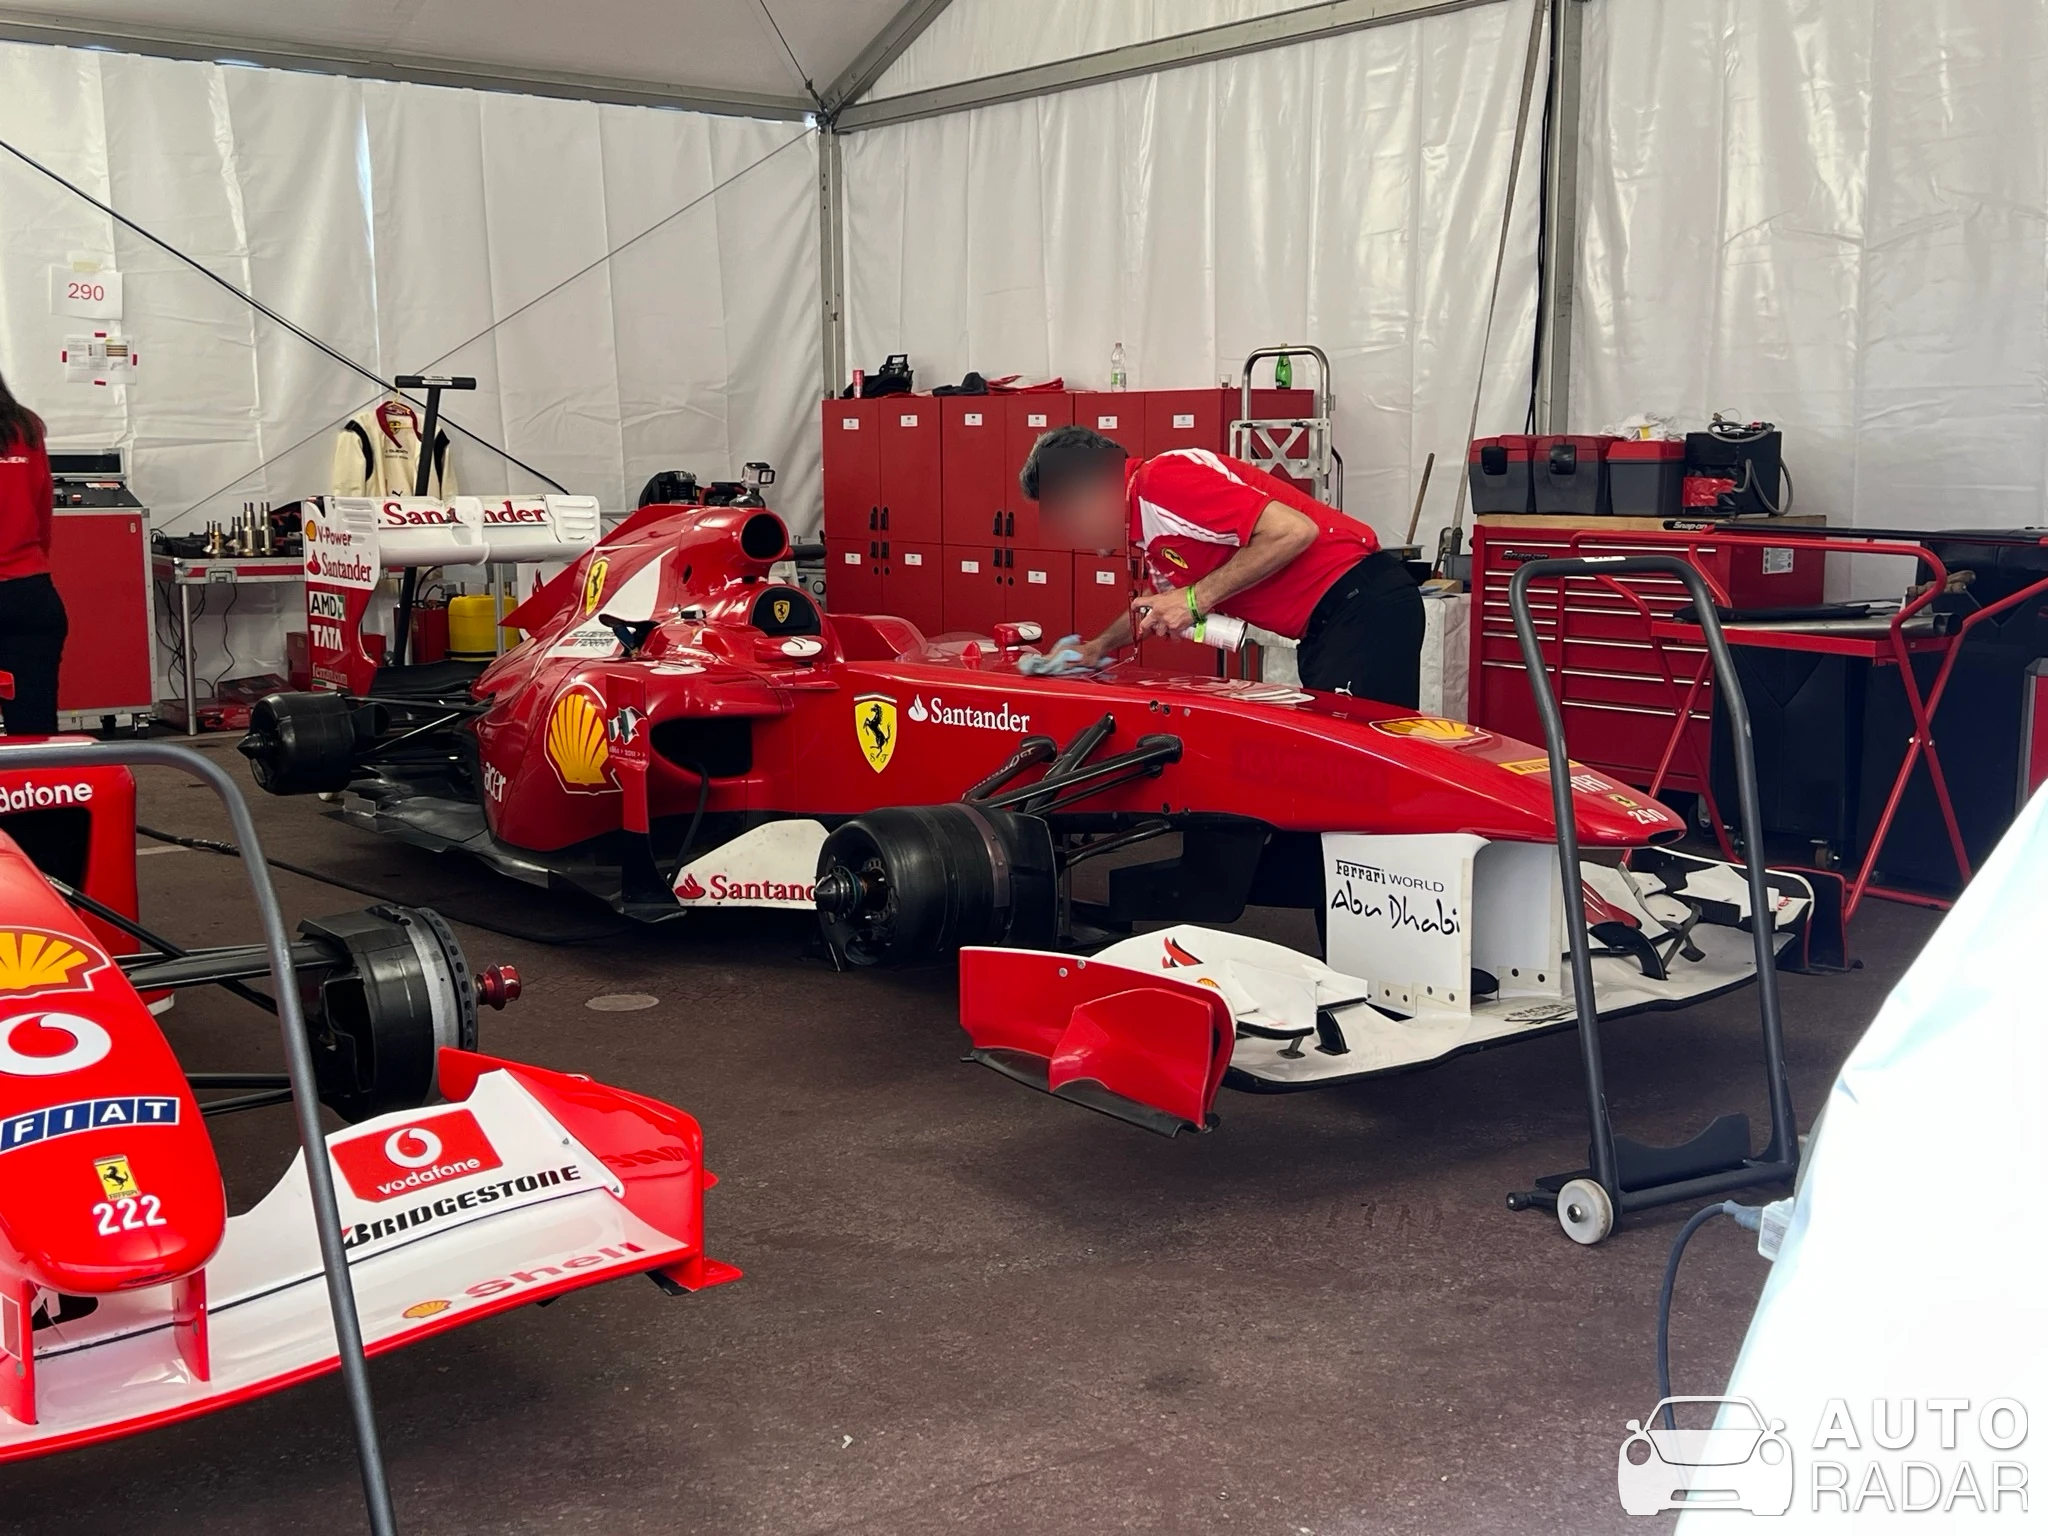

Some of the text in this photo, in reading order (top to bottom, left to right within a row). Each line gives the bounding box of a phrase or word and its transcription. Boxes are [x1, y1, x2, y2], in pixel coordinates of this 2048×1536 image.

[67, 282, 105, 302] 290
[382, 500, 546, 526] Santnder
[317, 526, 353, 546] V-Power
[321, 551, 372, 583] Santander
[310, 593, 337, 617] AMD
[310, 624, 344, 652] TATA
[930, 697, 1030, 733] Santander
[484, 761, 507, 802] acer
[1627, 808, 1669, 825] 290
[709, 874, 817, 902] Santan
[1335, 859, 1445, 893] Ferrari WORLD
[1331, 880, 1461, 936] Abu Dhabi
[13, 1102, 168, 1143] FIAT
[376, 1156, 481, 1195] vodafone
[92, 1194, 168, 1237] 222
[343, 1165, 582, 1250] BRIDGESTONE
[464, 1242, 646, 1299] Shell
